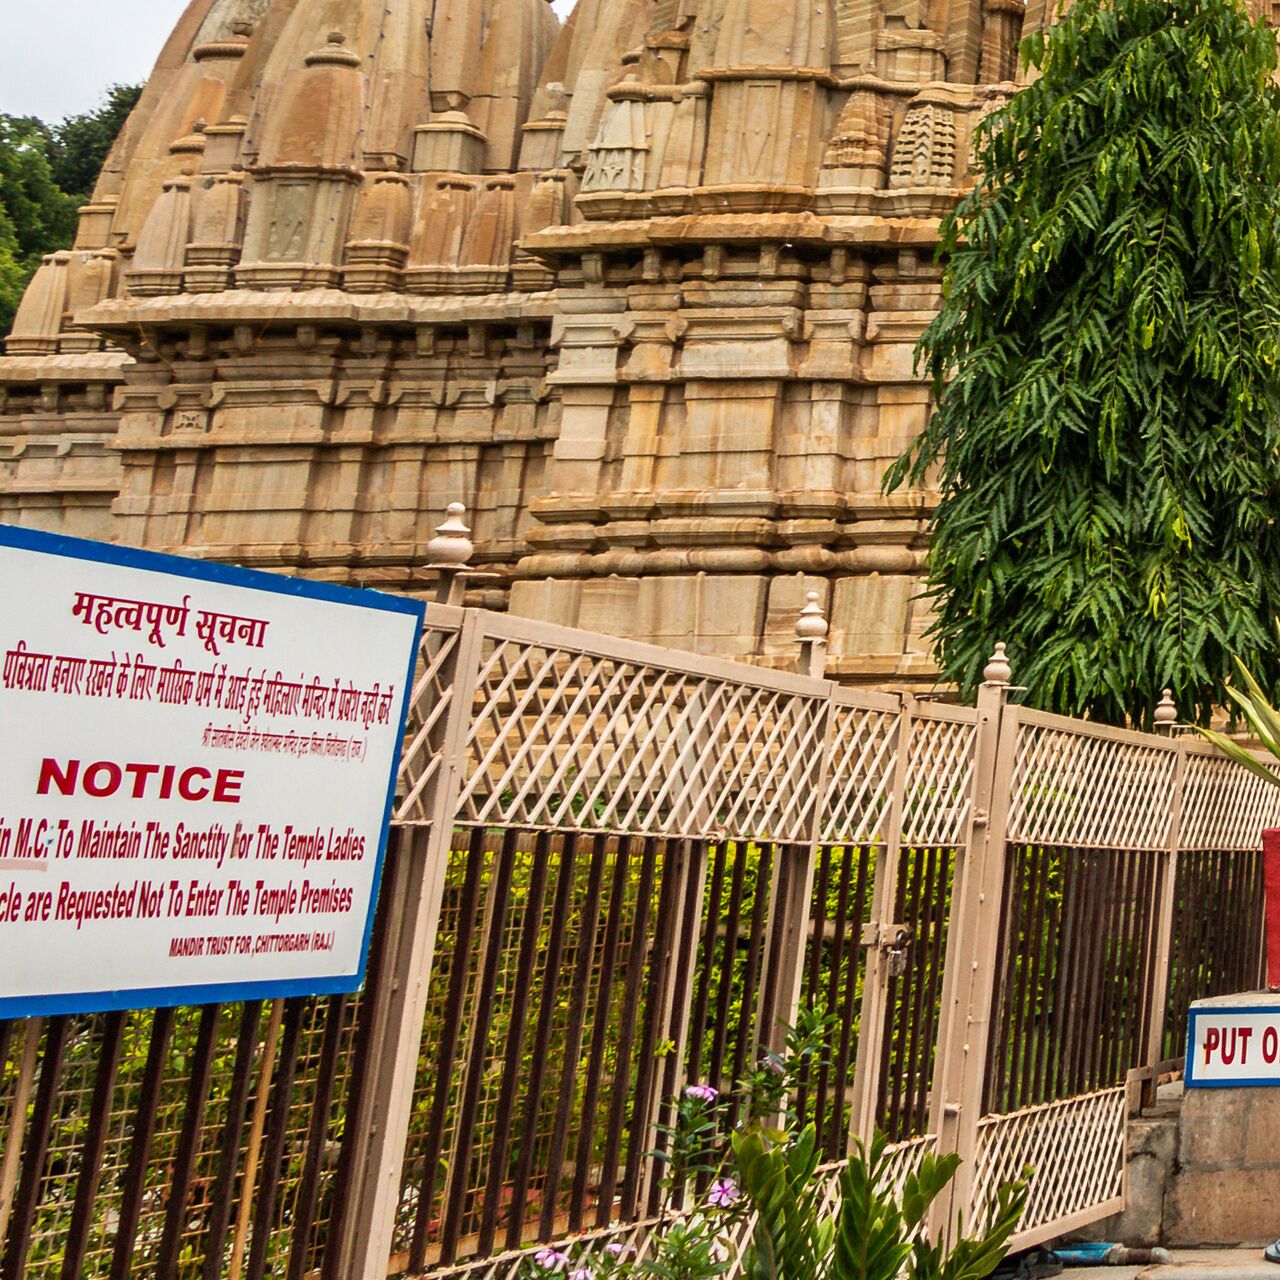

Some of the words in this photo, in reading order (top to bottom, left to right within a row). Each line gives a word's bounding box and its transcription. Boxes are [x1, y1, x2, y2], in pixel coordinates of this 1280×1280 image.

[72, 592, 191, 648] महत्वपूर्ण
[196, 610, 270, 656] सूचना
[3, 640, 53, 691] पवित्रता
[116, 652, 131, 698] के
[129, 653, 157, 701] लिए
[156, 658, 196, 705] मासिक
[195, 663, 218, 707] धर्म
[214, 664, 227, 708] में
[224, 667, 252, 715] आई
[243, 669, 266, 724] हुई
[328, 678, 340, 720] में
[36, 757, 245, 803] NOTICE
[56, 819, 74, 858] To
[76, 820, 142, 858] Maintain
[144, 821, 170, 859] The
[173, 821, 230, 869] Sanctity
[229, 820, 253, 859] For
[255, 824, 279, 859] The
[282, 825, 325, 868] Temple
[325, 826, 365, 861] Ladies
[25, 891, 52, 922] are
[55, 880, 138, 930] Requested
[137, 880, 165, 918] Not
[167, 880, 183, 918] To
[185, 880, 224, 917] Enter
[225, 880, 250, 916] The
[253, 880, 297, 924] Temple
[298, 879, 353, 914] Premises
[169, 937, 204, 957] MANDIR
[205, 936, 234, 956] TRUST
[234, 935, 251, 954] FOR
[1204, 1027, 1252, 1065] PUT
